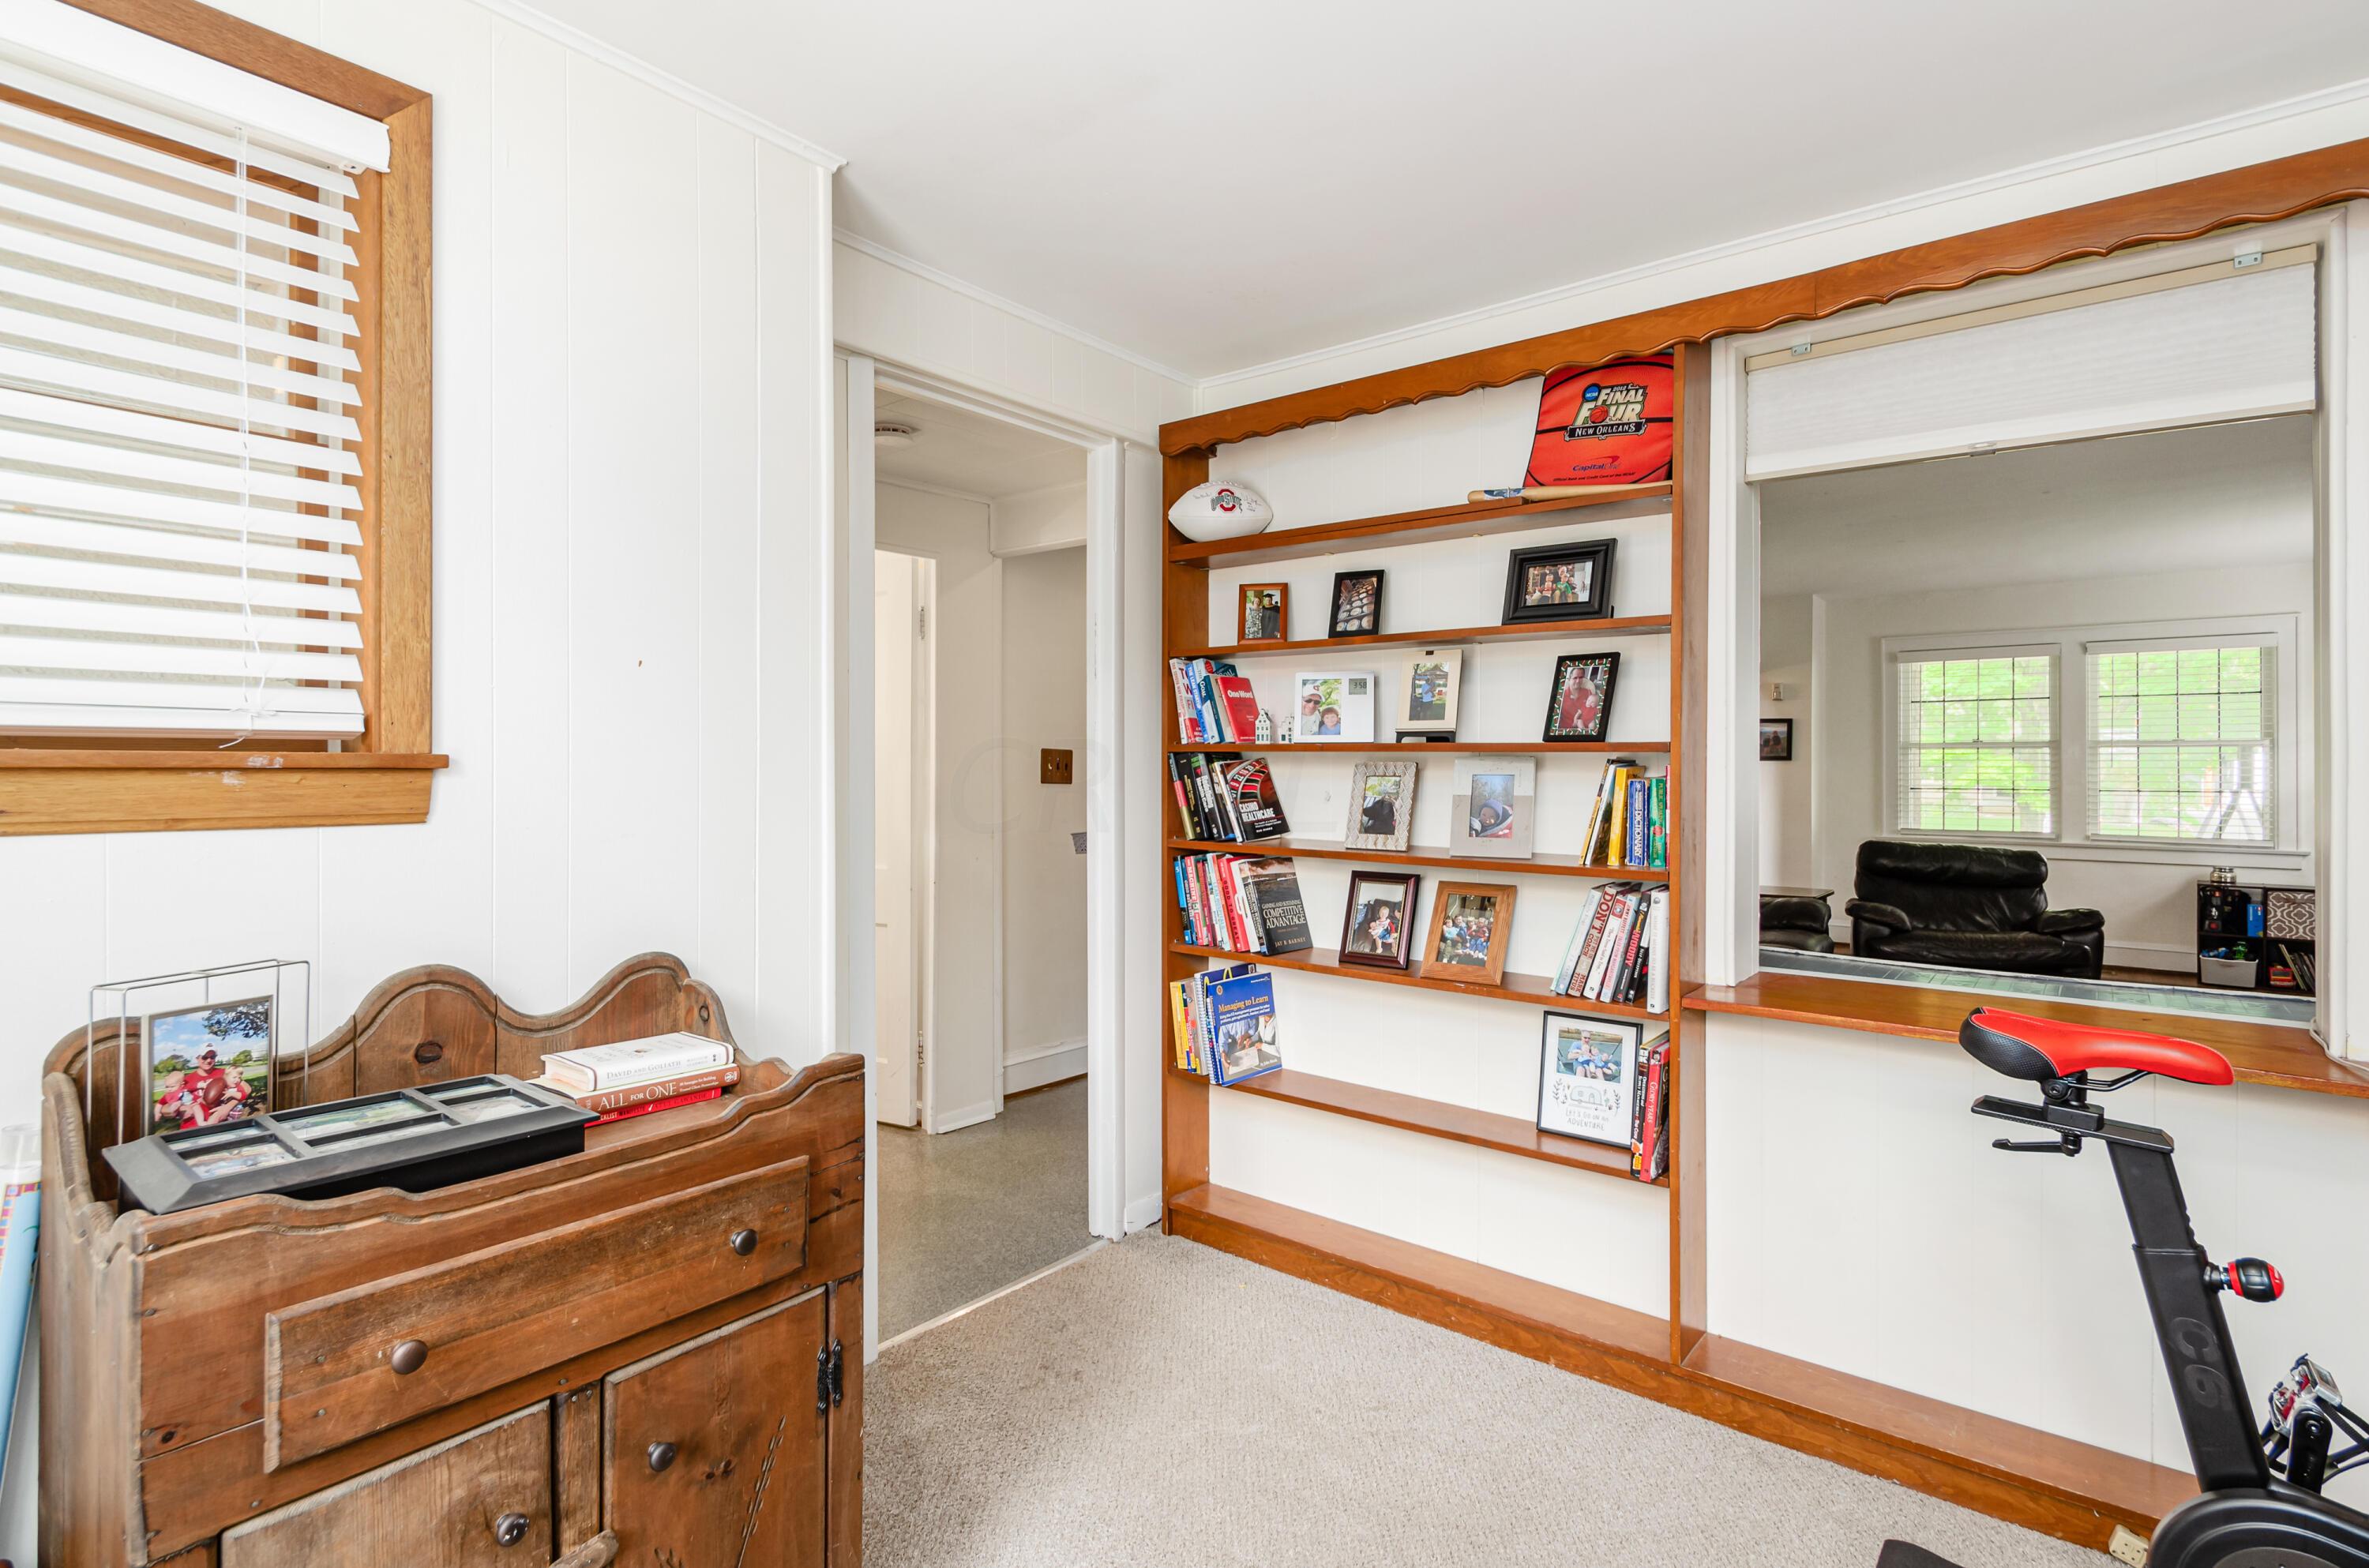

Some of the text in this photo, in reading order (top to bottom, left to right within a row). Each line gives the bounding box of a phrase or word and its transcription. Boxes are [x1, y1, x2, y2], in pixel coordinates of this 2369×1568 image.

[1596, 387, 1645, 406] FINAL
[1575, 423, 1636, 437] NEW ORLEANS
[1239, 802, 1259, 812] CASINO
[1241, 808, 1275, 822] HEALTHCARE
[1633, 810, 1643, 857] DICTIONARY
[1223, 880, 1239, 940] GOOD TO GREAT
[1263, 905, 1304, 918] COMPETITIVE
[1590, 890, 1614, 934] DON'T
[1267, 914, 1306, 929] ADVANTAGE
[1582, 933, 1594, 956] COACH
[1624, 930, 1640, 967] WOODY
[1569, 971, 1580, 991] TITUS
[1575, 973, 1586, 993] MARK
[1218, 1001, 1245, 1013] Managing
[1251, 996, 1269, 1004] Learn
[607, 1070, 632, 1079] DAVID
[647, 1061, 681, 1071] GOLIATH
[597, 1092, 629, 1111] ALL
[646, 1082, 677, 1100] ONE
[2169, 1317, 2233, 1411] C6
